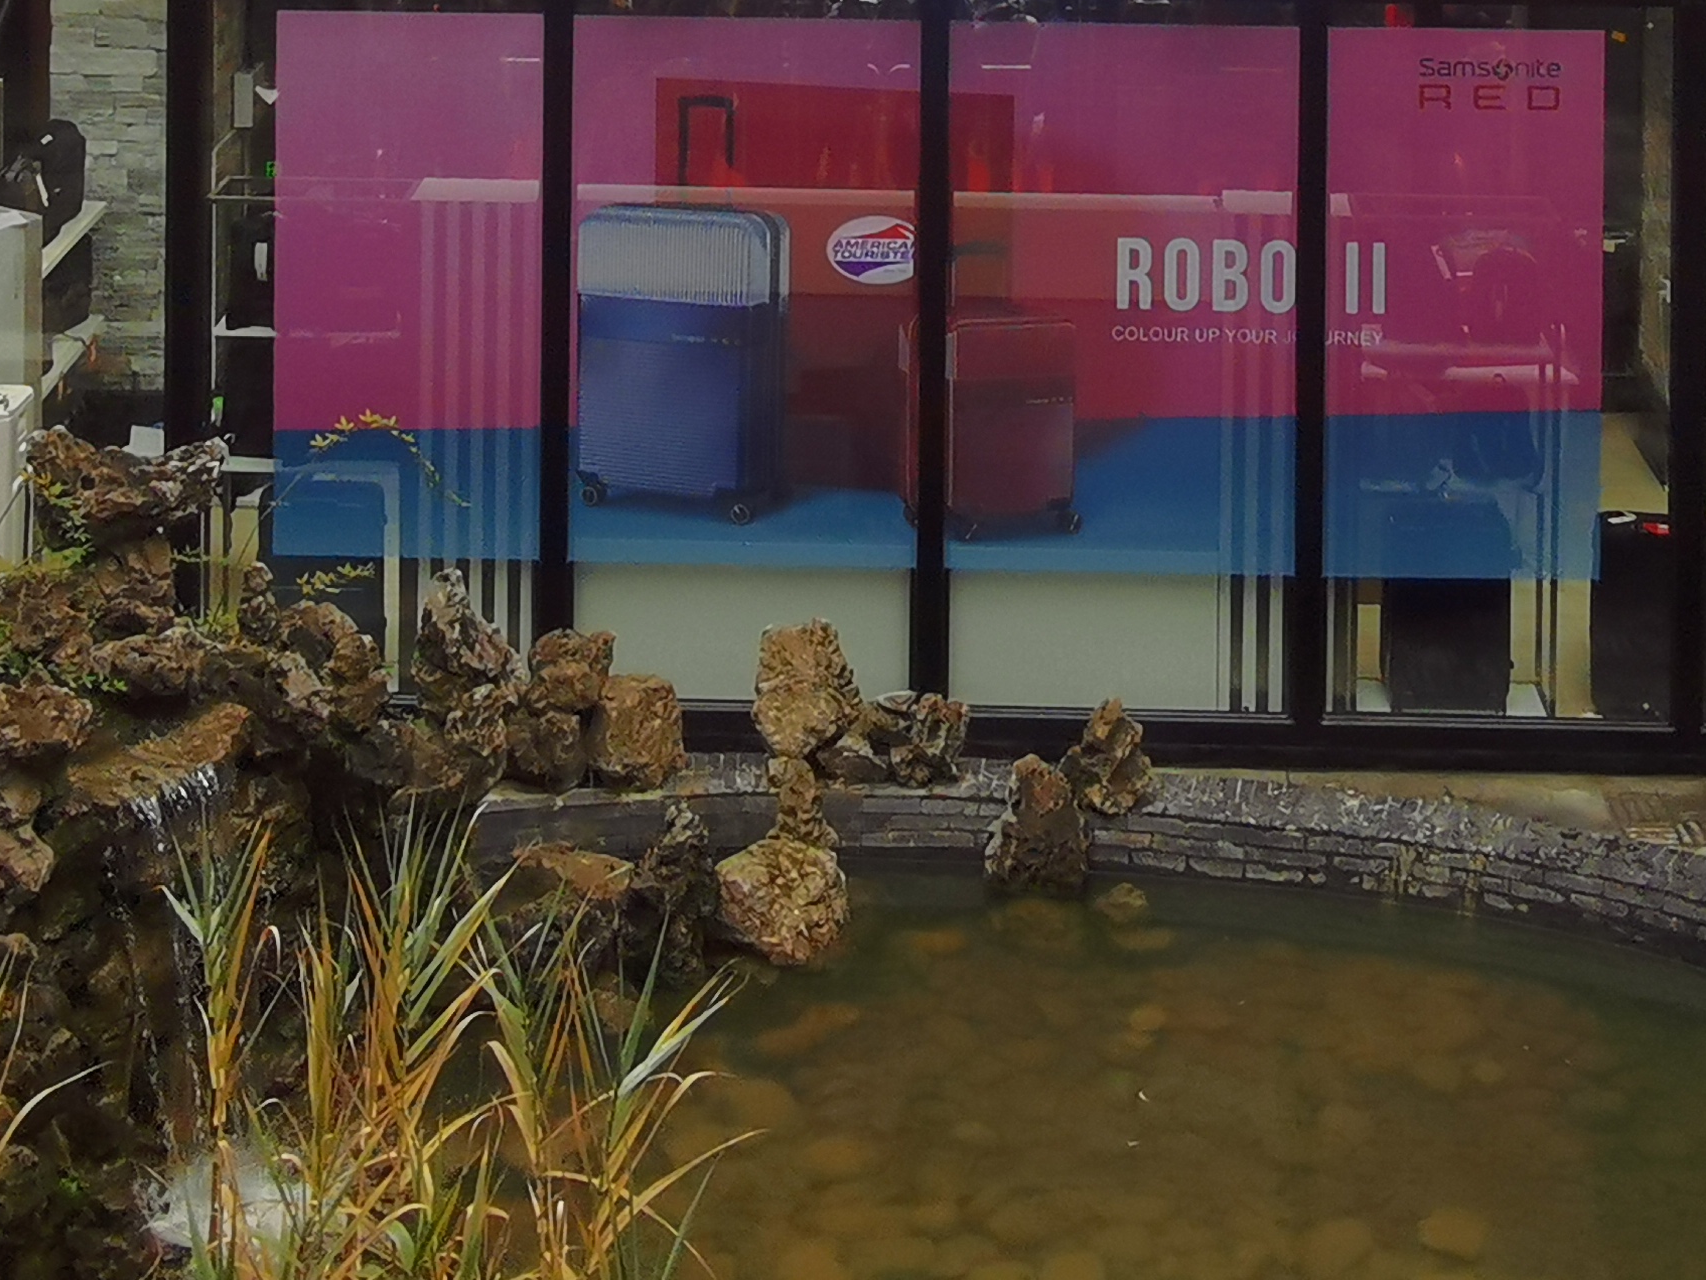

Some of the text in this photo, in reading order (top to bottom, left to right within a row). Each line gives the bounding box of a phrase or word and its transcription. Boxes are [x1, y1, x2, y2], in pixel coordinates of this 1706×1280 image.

[1419, 57, 1562, 81] Samsonite
[1418, 84, 1561, 111] RED
[833, 249, 915, 260] TOURISTE
[1116, 236, 1296, 314] ROBO
[1111, 325, 1189, 342] COLOUR
[1195, 327, 1221, 342] UP
[1225, 328, 1277, 344] YOUR
